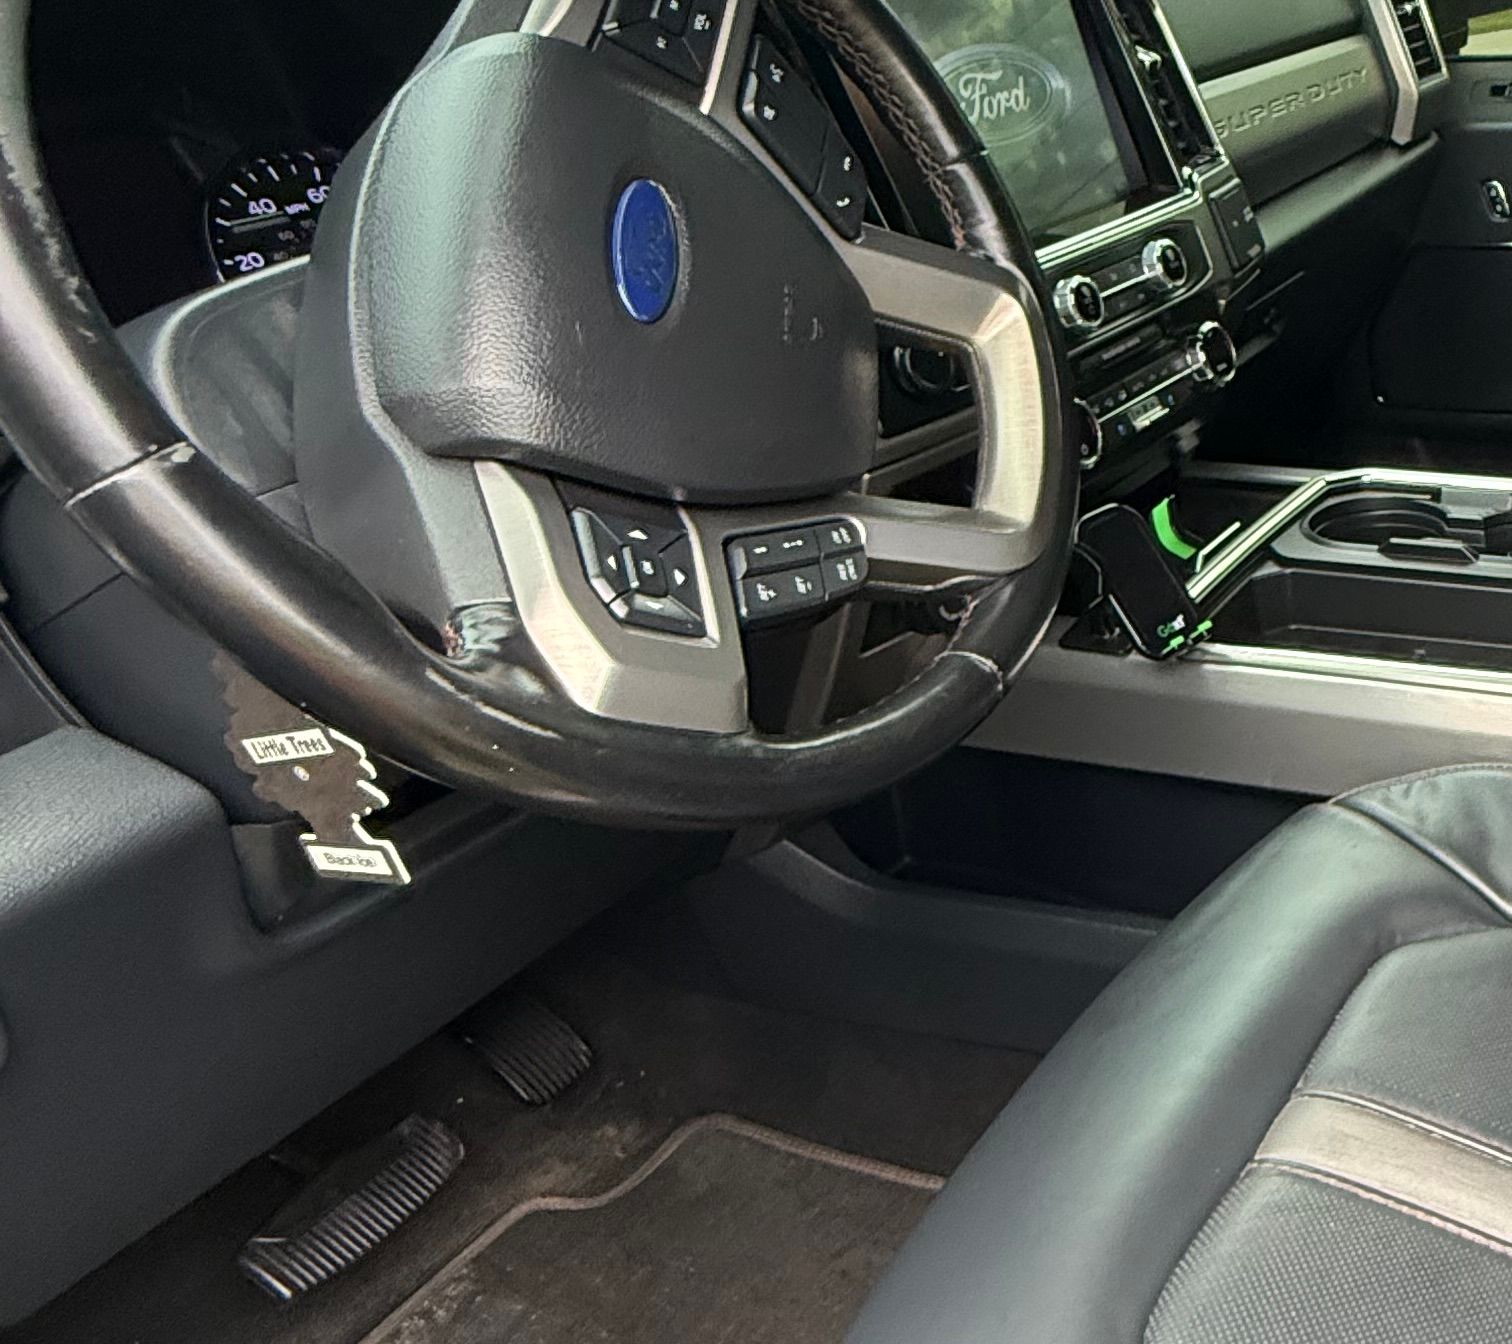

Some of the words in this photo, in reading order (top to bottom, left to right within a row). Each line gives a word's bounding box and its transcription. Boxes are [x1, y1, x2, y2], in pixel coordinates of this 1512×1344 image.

[957, 69, 1030, 126] Ford
[1213, 91, 1306, 139] SUPER
[1306, 66, 1368, 102] DUTY
[248, 197, 278, 216] 40
[284, 202, 312, 216] MPH
[234, 252, 265, 272] 20
[250, 738, 289, 760] Little
[285, 735, 327, 755] Trees
